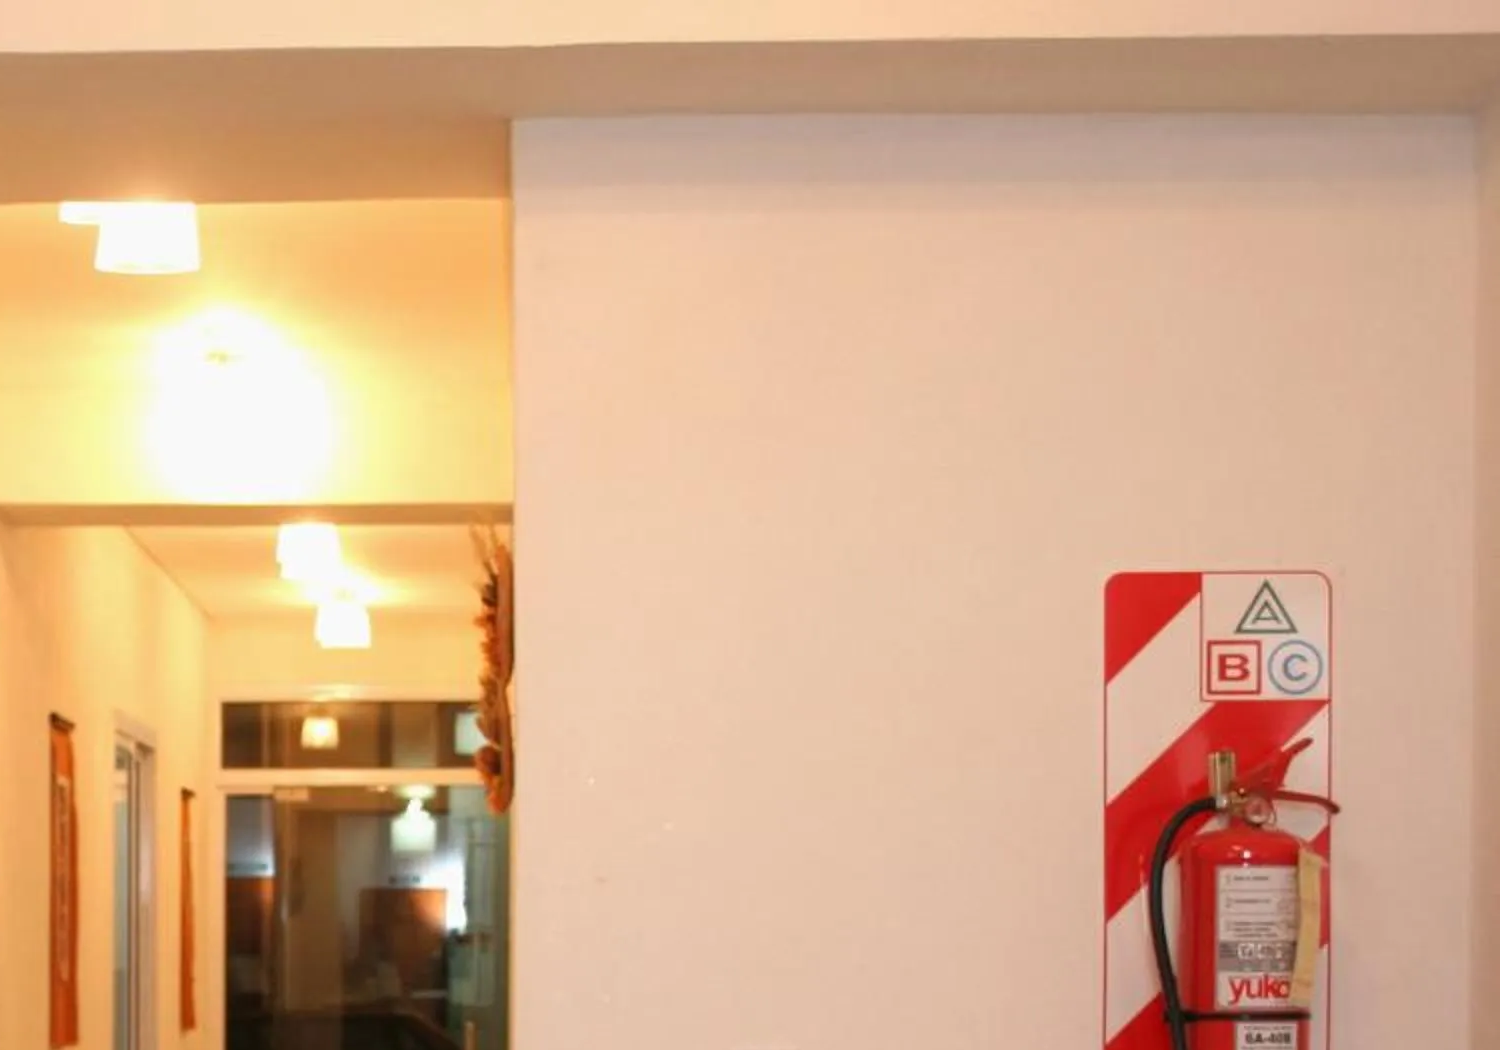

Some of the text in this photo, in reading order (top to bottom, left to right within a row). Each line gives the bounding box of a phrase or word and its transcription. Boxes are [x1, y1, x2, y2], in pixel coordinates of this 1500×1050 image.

[1251, 600, 1282, 624] A
[1217, 653, 1308, 682] B C
